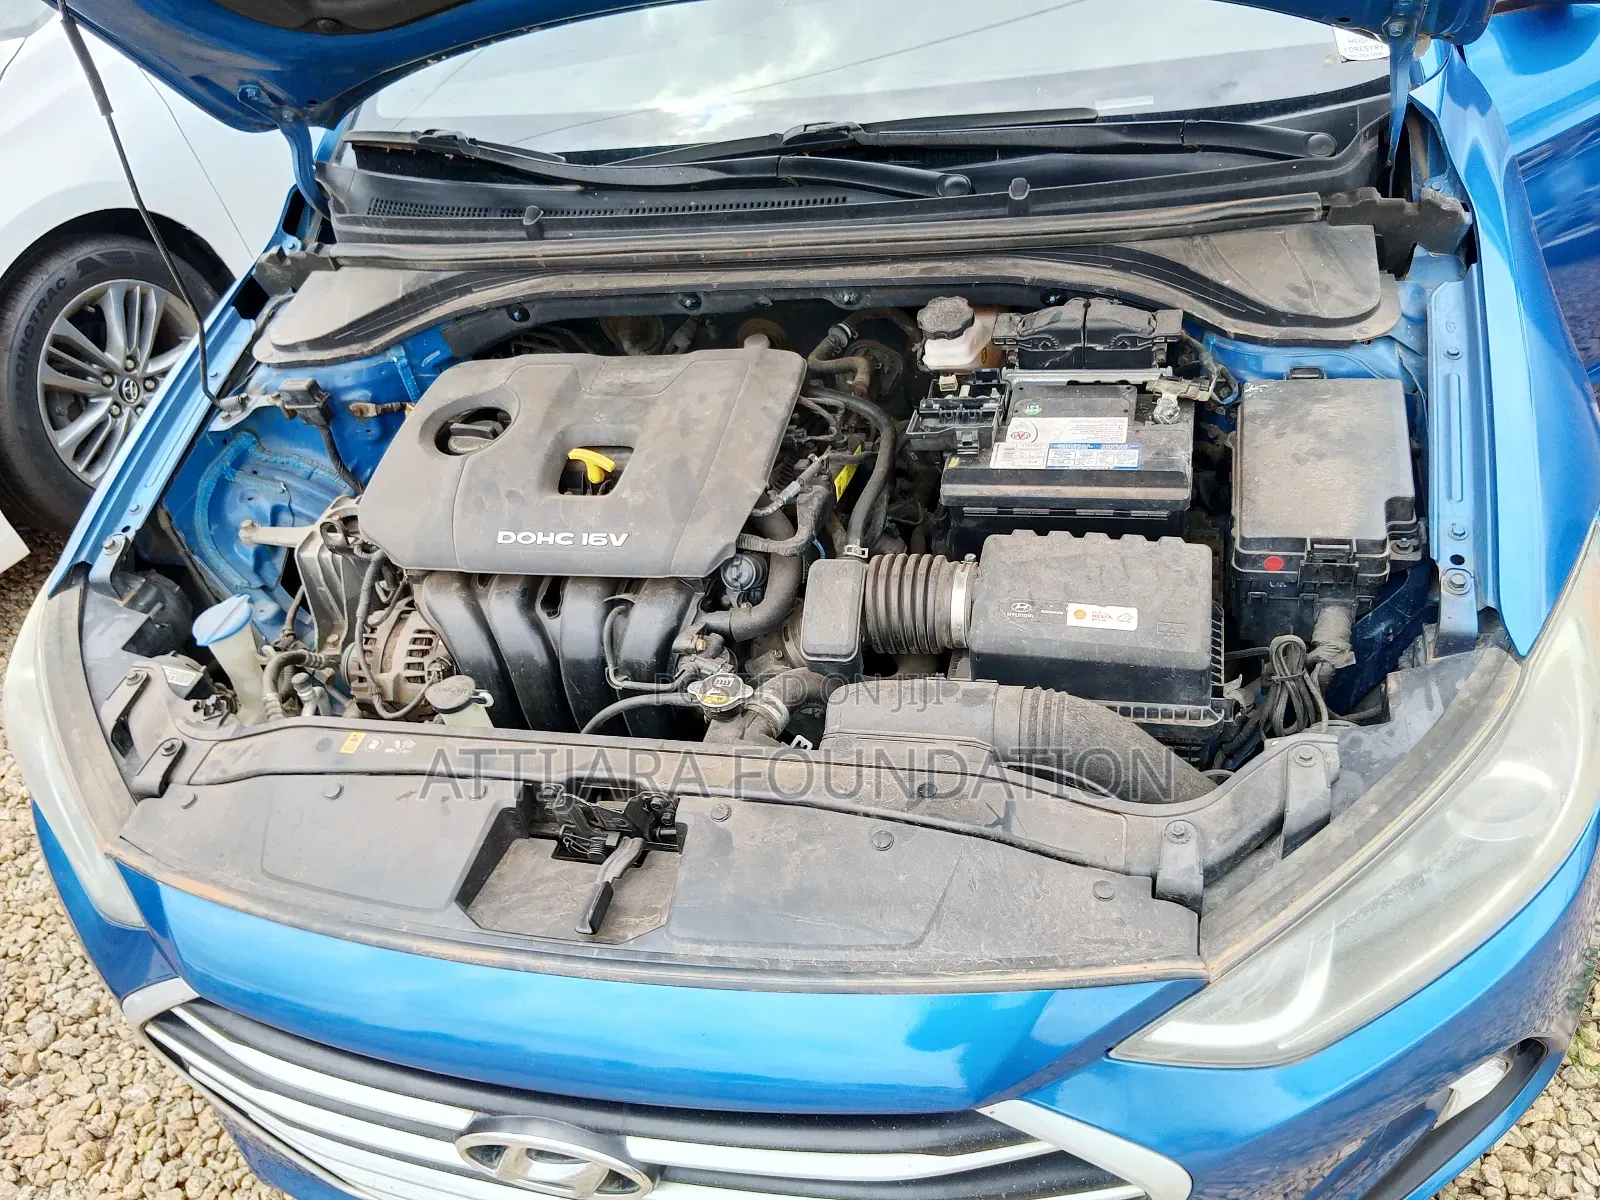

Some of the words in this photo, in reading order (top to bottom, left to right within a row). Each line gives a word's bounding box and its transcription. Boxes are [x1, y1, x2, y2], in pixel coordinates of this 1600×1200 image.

[1344, 44, 1384, 53] FORESTRY
[496, 530, 576, 546] DOHC
[580, 532, 630, 548] 16V
